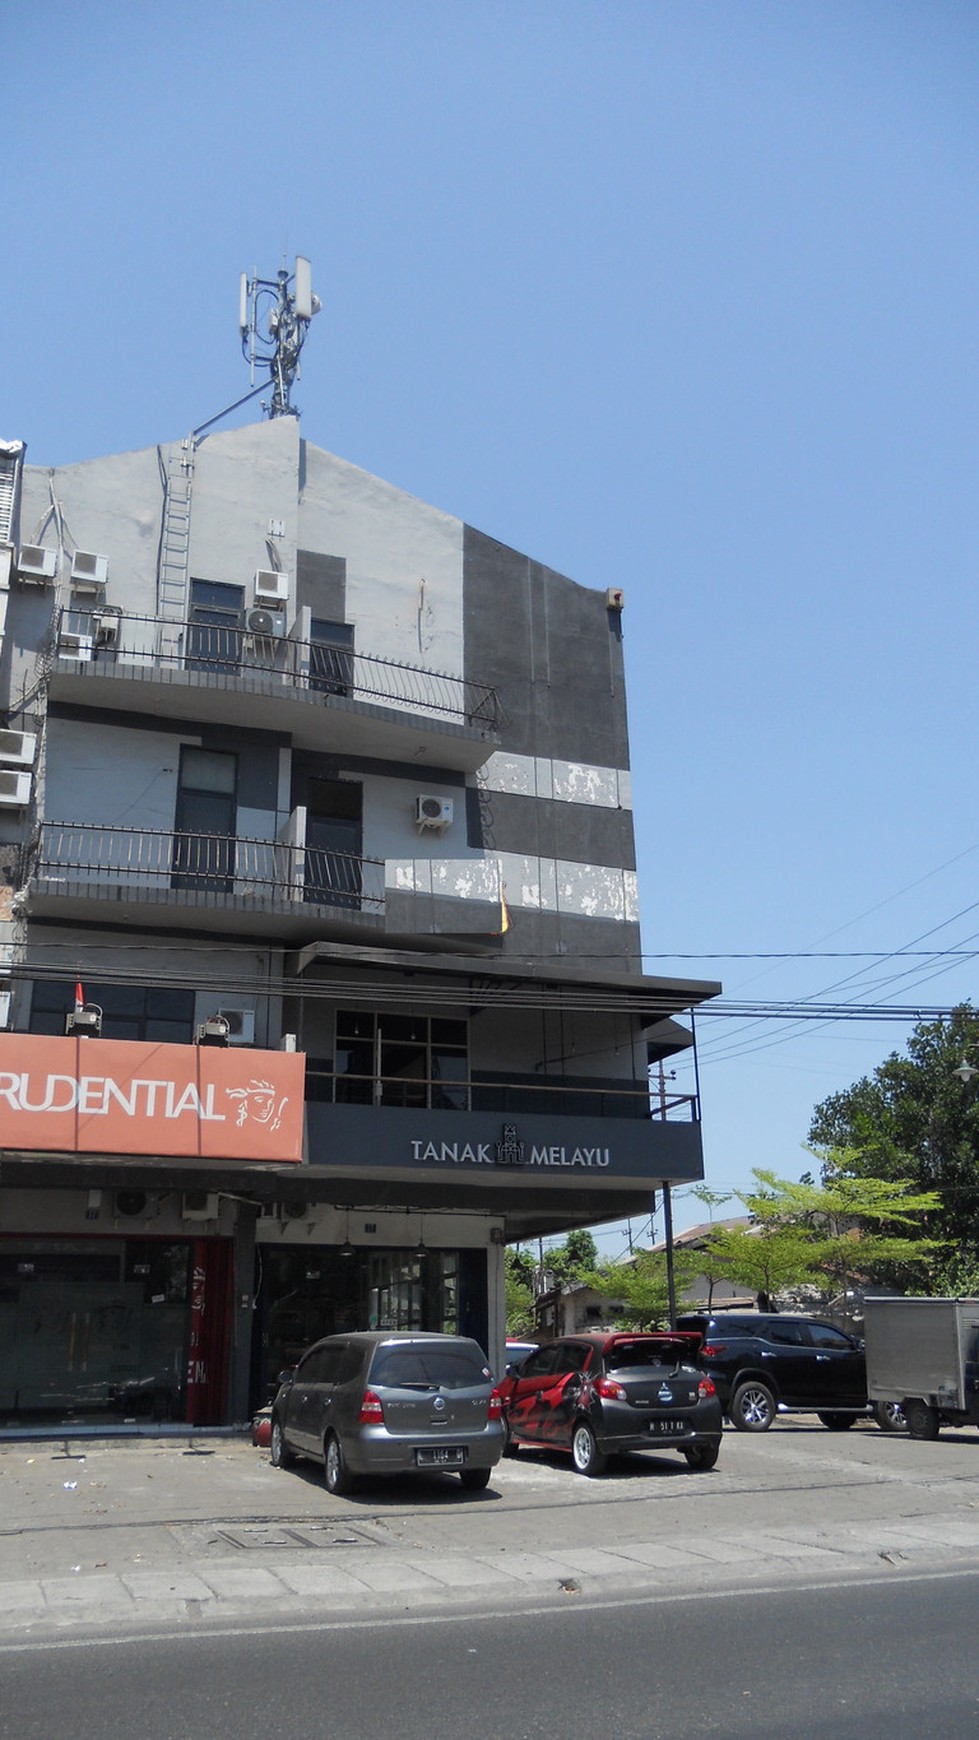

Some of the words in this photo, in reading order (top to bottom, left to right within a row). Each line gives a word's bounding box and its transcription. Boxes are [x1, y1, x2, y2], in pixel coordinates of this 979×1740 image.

[0, 1072, 226, 1121] RUDENTIAL
[411, 1140, 494, 1164] TANAK
[530, 1146, 610, 1167] MELAYU
